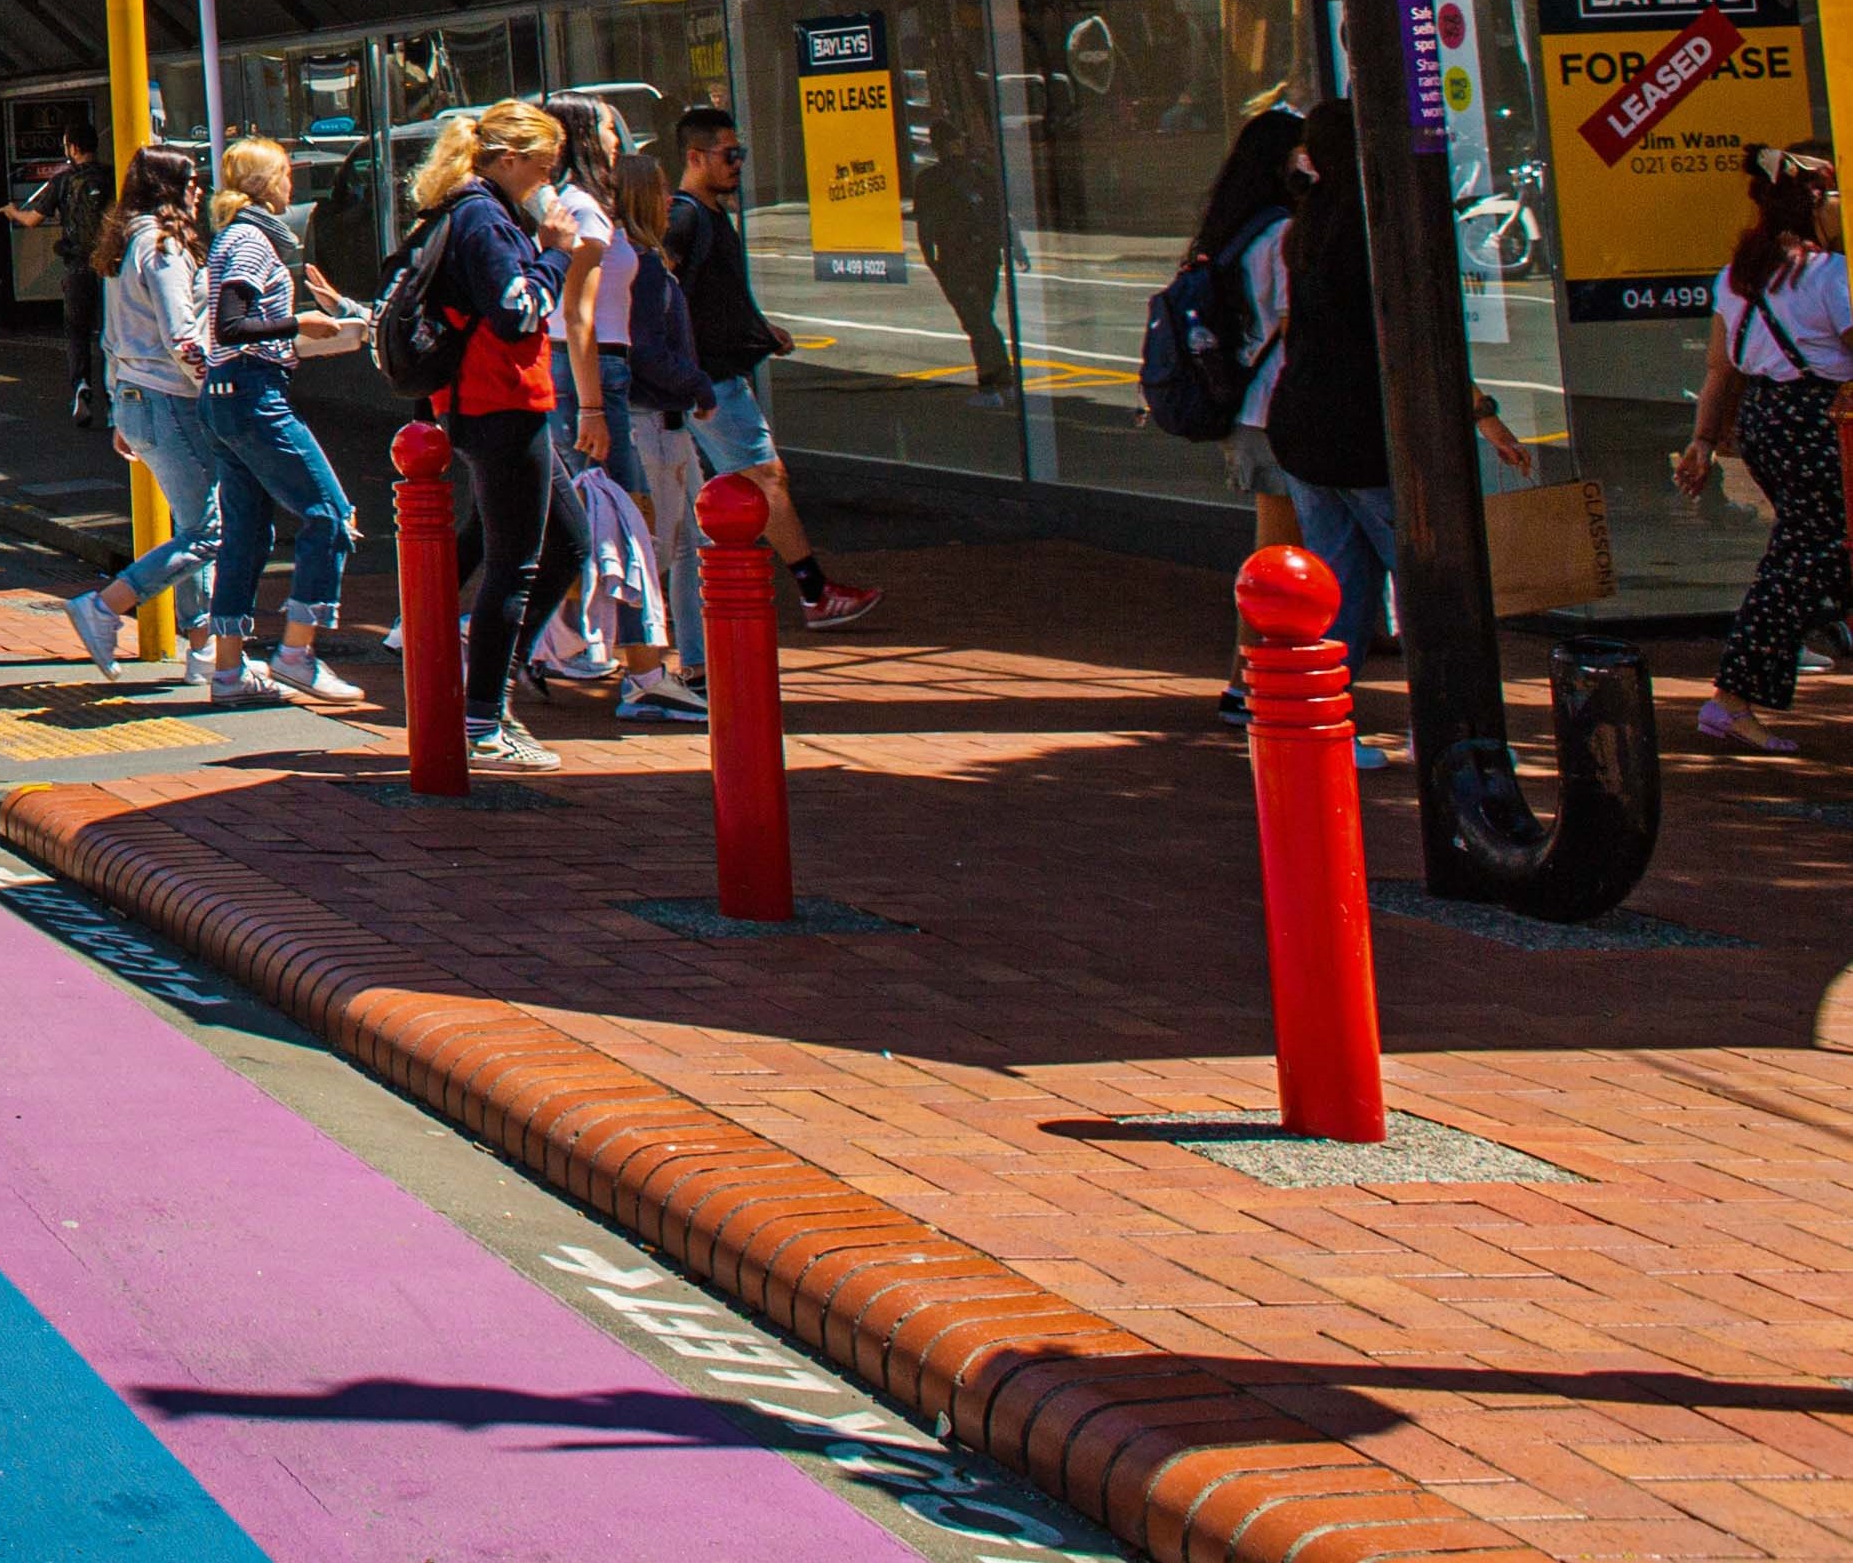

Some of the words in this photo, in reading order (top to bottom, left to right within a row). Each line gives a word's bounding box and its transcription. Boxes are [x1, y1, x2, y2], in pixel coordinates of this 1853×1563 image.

[813, 33, 869, 58] BAYLEYS
[1606, 36, 1713, 138] LEASED
[805, 89, 837, 114] FOR
[838, 85, 888, 111] LEASE
[1639, 132, 1675, 150] Jim
[1680, 131, 1741, 149] Wana
[1630, 156, 1665, 175] 021
[1670, 154, 1708, 173] 623
[832, 259, 845, 274] 04
[846, 259, 862, 274] 499
[1622, 288, 1656, 309] 04
[1661, 286, 1708, 307] 499
[586, 1284, 840, 1394] LEFT
